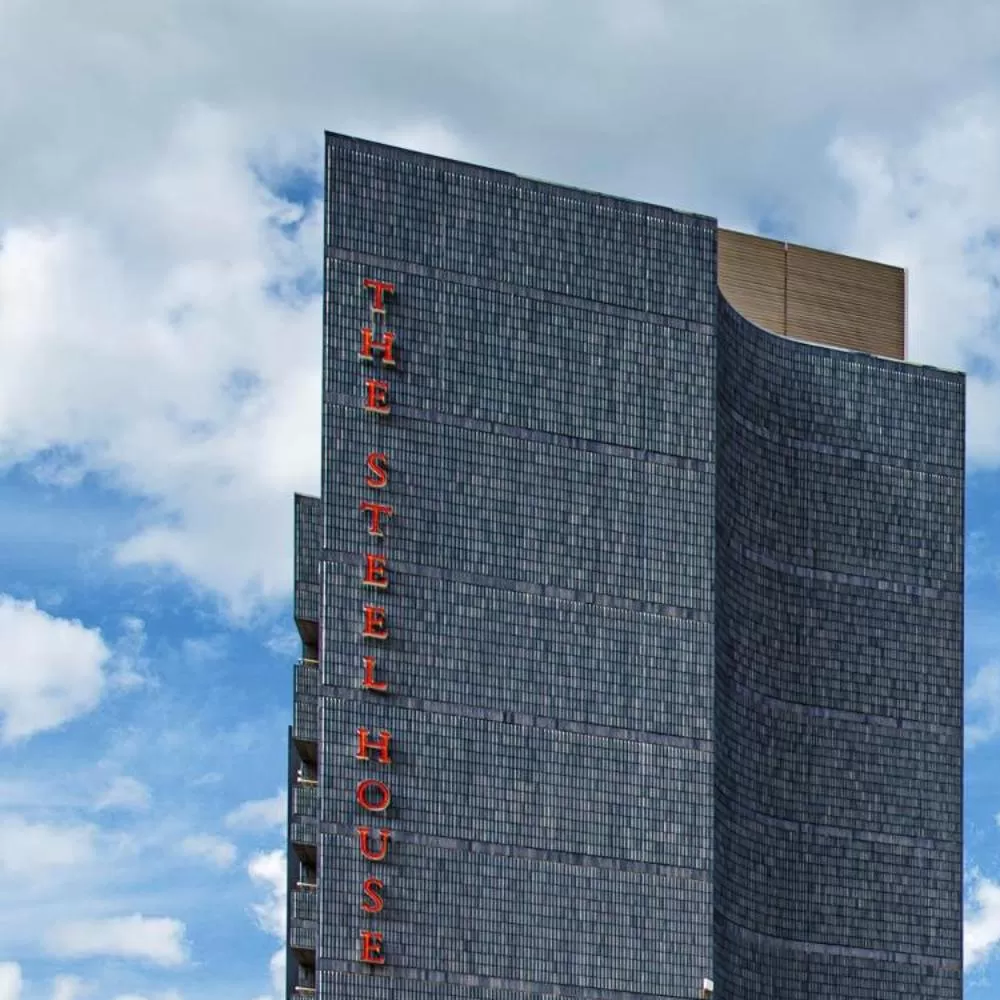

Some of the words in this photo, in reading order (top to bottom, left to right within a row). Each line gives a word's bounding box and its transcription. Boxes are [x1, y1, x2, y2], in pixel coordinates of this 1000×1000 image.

[360, 279, 395, 413] THE
[360, 453, 393, 690] STEEL
[355, 727, 392, 965] HOUSE
